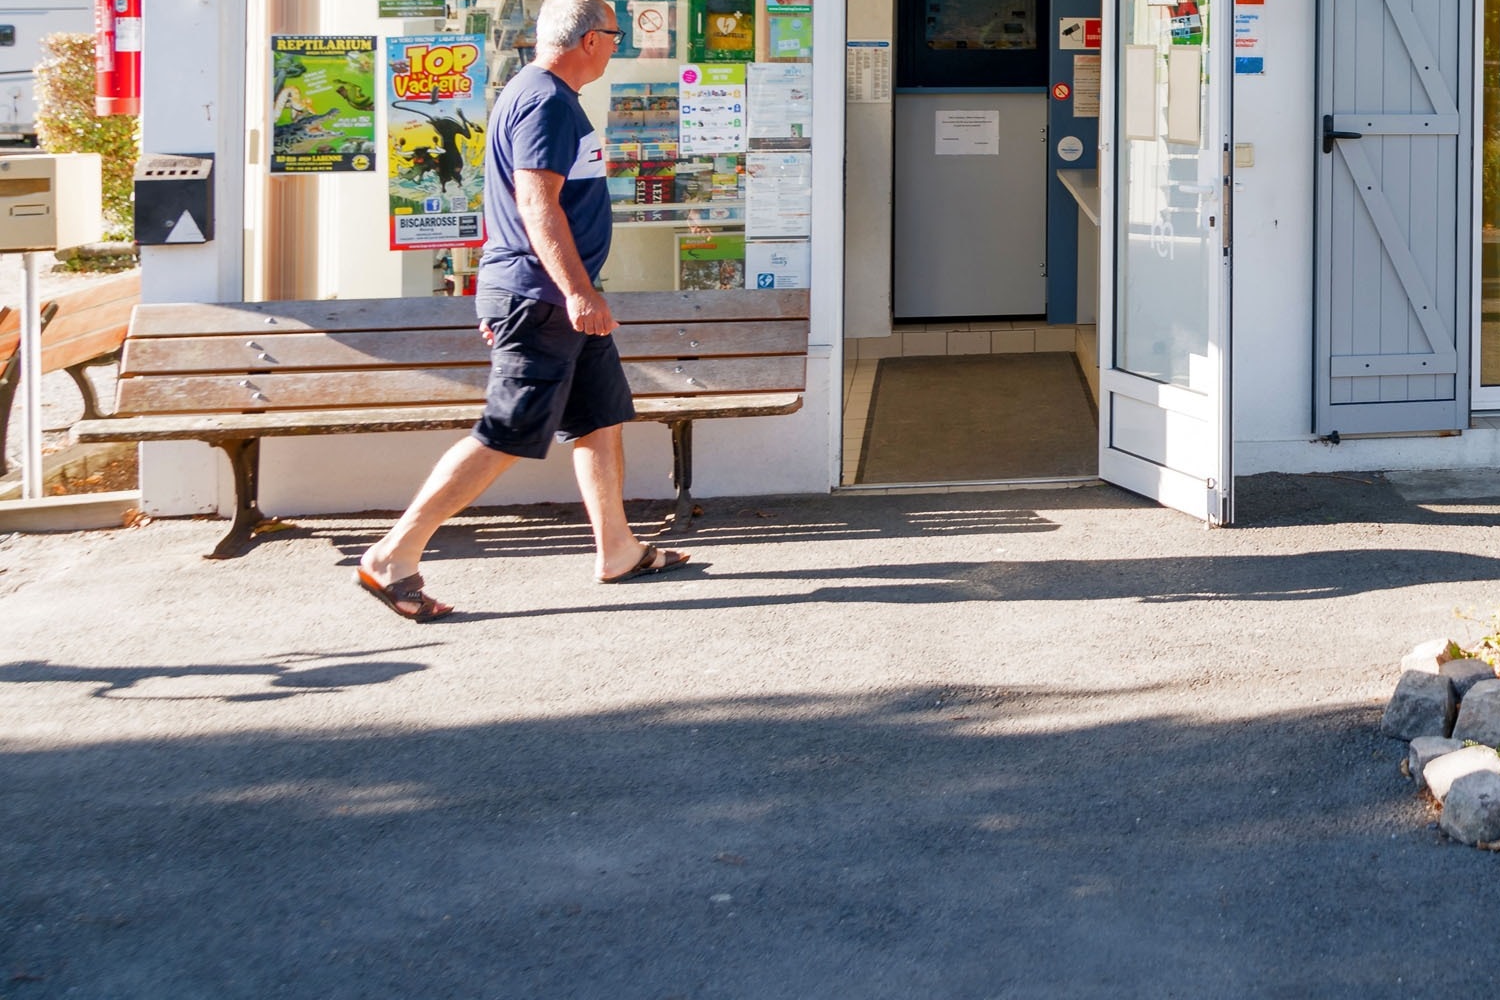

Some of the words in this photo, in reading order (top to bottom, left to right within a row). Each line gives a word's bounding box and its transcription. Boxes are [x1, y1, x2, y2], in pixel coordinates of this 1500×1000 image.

[277, 39, 372, 51] REPTILARIUM
[406, 44, 479, 75] TOP
[394, 75, 473, 98] Vachette
[400, 216, 457, 228] BISCARROSSE
